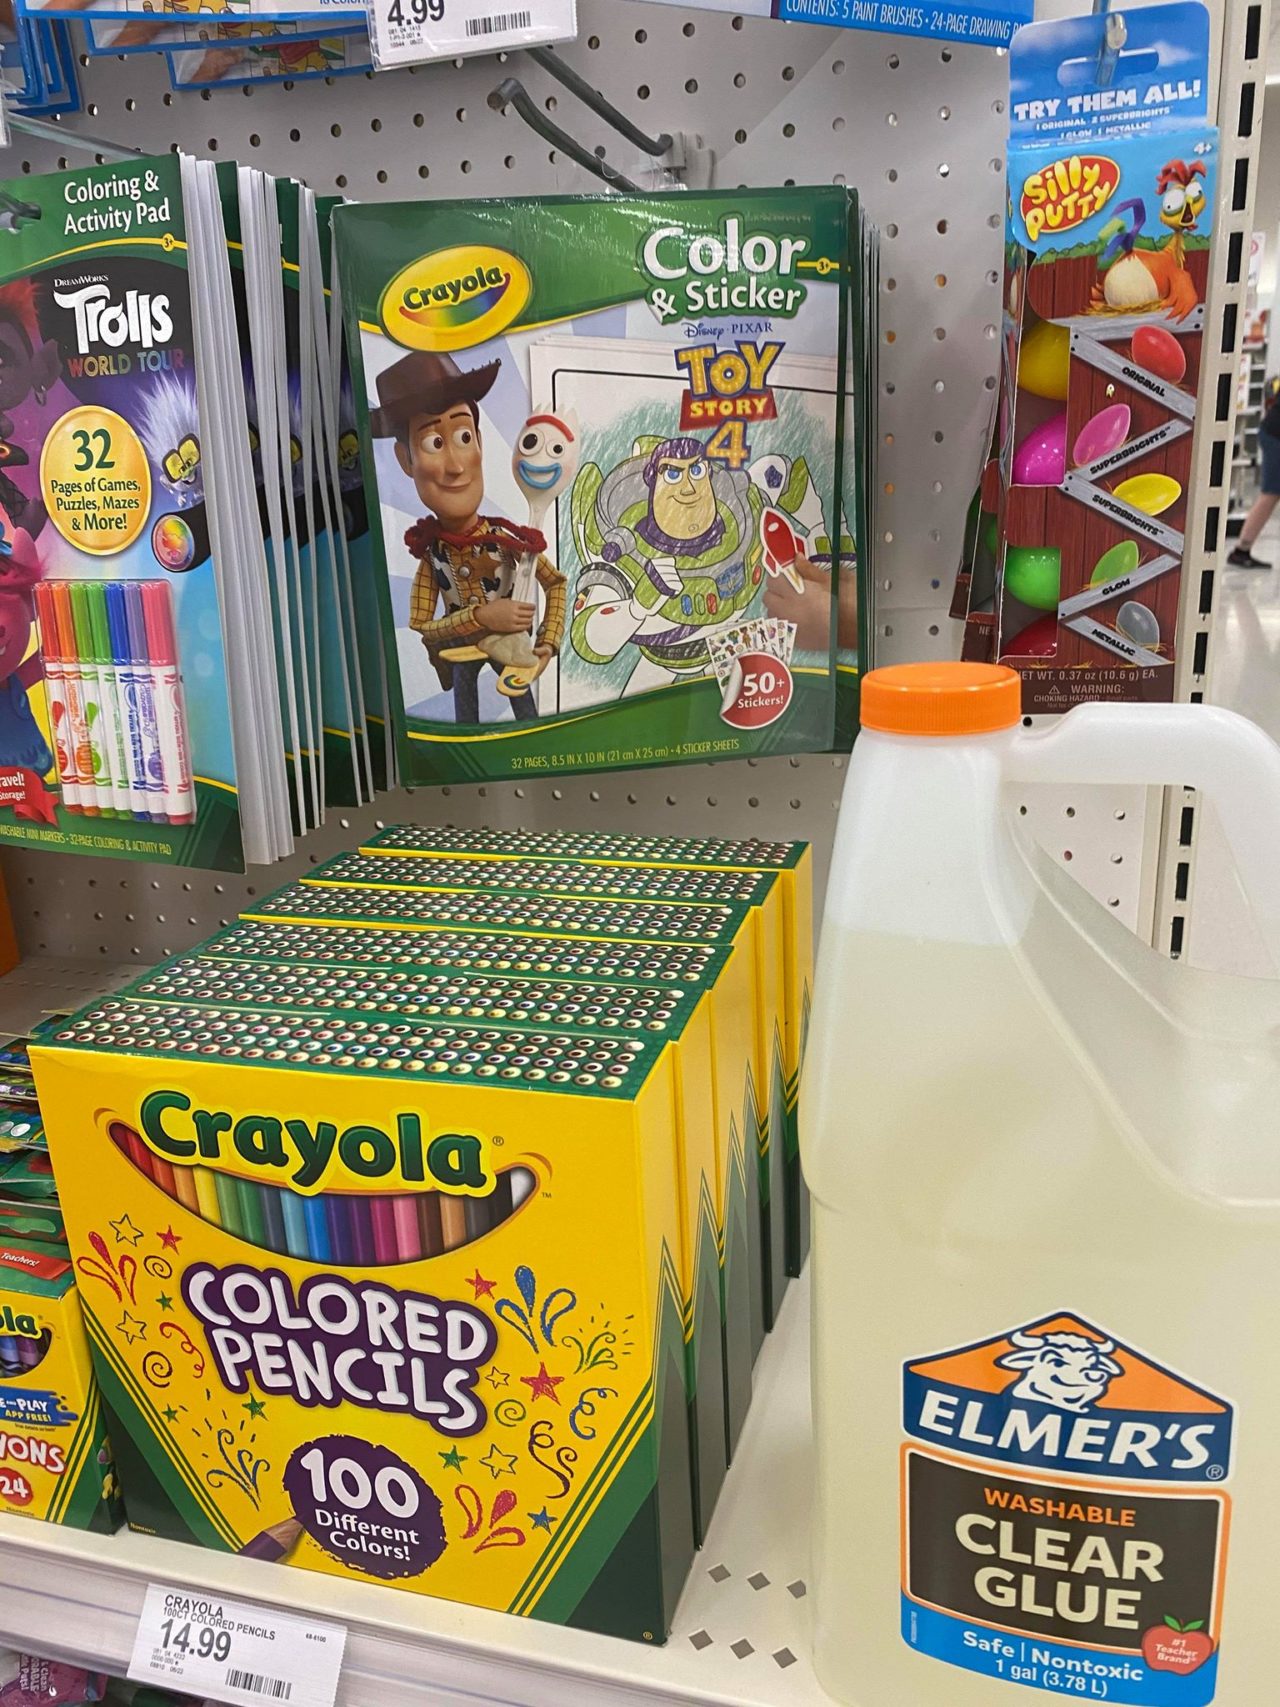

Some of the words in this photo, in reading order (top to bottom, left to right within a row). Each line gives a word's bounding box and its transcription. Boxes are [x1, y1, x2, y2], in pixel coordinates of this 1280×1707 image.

[387, 0, 445, 26] 4.99
[786, 0, 838, 17] CONTENTS:
[842, 1, 849, 18] 5
[851, 1, 879, 22] PAINT
[880, 4, 924, 28] BRUSHES
[930, 11, 968, 34] 24-PAGE
[969, 16, 1011, 39] DRAWING
[1014, 98, 1061, 120] TRY
[1067, 88, 1137, 114] THEM
[1143, 79, 1201, 104] ALL!
[1042, 118, 1087, 130] ORIGINAL
[1066, 129, 1092, 138] GLOW
[1105, 121, 1152, 134] METALLIC
[64, 174, 140, 203] Coloring
[144, 169, 160, 191] &
[1024, 155, 1101, 205] Silly
[64, 206, 132, 235] Activity
[135, 197, 171, 225] Pad
[1025, 181, 1111, 242] PUTTY
[643, 218, 806, 280] Color
[403, 266, 503, 310] Crayola
[651, 287, 678, 317] &
[685, 276, 802, 312] Sticker
[53, 284, 174, 354] Trolls
[731, 322, 773, 335] PIXAR
[67, 353, 131, 378] WORLD
[137, 348, 184, 372] TOUR
[674, 340, 786, 399] TOY
[1121, 366, 1165, 397] ORIGINAL
[690, 397, 768, 418] STORY
[72, 428, 116, 471] 32
[703, 417, 752, 470] 4
[51, 479, 82, 497] Pages
[84, 477, 95, 493] of
[99, 477, 141, 492] Games,
[56, 497, 100, 512] Puzzles,
[102, 496, 139, 510] Mazes
[72, 520, 81, 532] &
[84, 512, 127, 531] More!
[1102, 578, 1131, 595] GLOW
[979, 625, 991, 636] NE
[1091, 628, 1136, 656] METALLIC
[743, 671, 785, 697] 50+
[1020, 671, 1034, 681] ET
[1037, 670, 1055, 680] WT.
[1059, 670, 1081, 681] 0.37
[1084, 672, 1096, 681] oz
[1099, 670, 1126, 682] (10.6
[1128, 670, 1139, 681] g)
[1142, 669, 1159, 679] EA.
[1071, 684, 1125, 694] WARNING:
[737, 695, 784, 709] Stickers!
[1033, 694, 1068, 702] CHOKING
[511, 757, 523, 769] 32
[524, 756, 549, 769] PAGES,
[551, 755, 565, 766] 8.5
[566, 753, 575, 765] IN
[576, 753, 582, 764] X
[585, 752, 595, 763] 10
[596, 751, 605, 762] IN
[606, 750, 620, 762] (21
[622, 751, 634, 760] cm
[635, 748, 641, 759] X
[643, 747, 653, 758] 25
[655, 746, 669, 757] cm)
[675, 744, 681, 755] 4
[682, 741, 711, 754] STICKER
[712, 738, 740, 751] SHEETS
[94, 836, 124, 850] COLORING
[132, 840, 158, 854] ACTIVITY
[159, 843, 172, 855] PAD
[140, 1089, 488, 1189] Crayola
[1, 1252, 40, 1267] Teachers!
[189, 1270, 488, 1361] COLORED
[211, 1328, 478, 1430] PENCILS
[5, 1409, 23, 1419] APP
[26, 1412, 52, 1421] FREE!
[919, 1389, 1215, 1470] ELMER'S
[0, 1476, 29, 1498] 24
[300, 1448, 420, 1519] 100
[983, 1486, 1136, 1527] WASHABLE
[315, 1508, 419, 1545] Different
[329, 1529, 411, 1561] Colors!
[955, 1513, 1164, 1582] CLEAR
[165, 1594, 223, 1619] CRAYOLA
[974, 1566, 1141, 1630] GLUE
[163, 1606, 189, 1620] 100CT
[190, 1612, 235, 1631] COLORED
[236, 1623, 277, 1641] PENCILS
[160, 1618, 232, 1662] 14.99
[962, 1631, 1016, 1658] Safe
[1031, 1648, 1144, 1681] Nontoxic
[1155, 1643, 1199, 1657] Teacher
[1171, 1638, 1187, 1647] #1
[996, 1659, 1004, 1673] 1
[1010, 1665, 1037, 1681] gal
[1042, 1670, 1087, 1692] (3.78
[1091, 1679, 1109, 1698] L)
